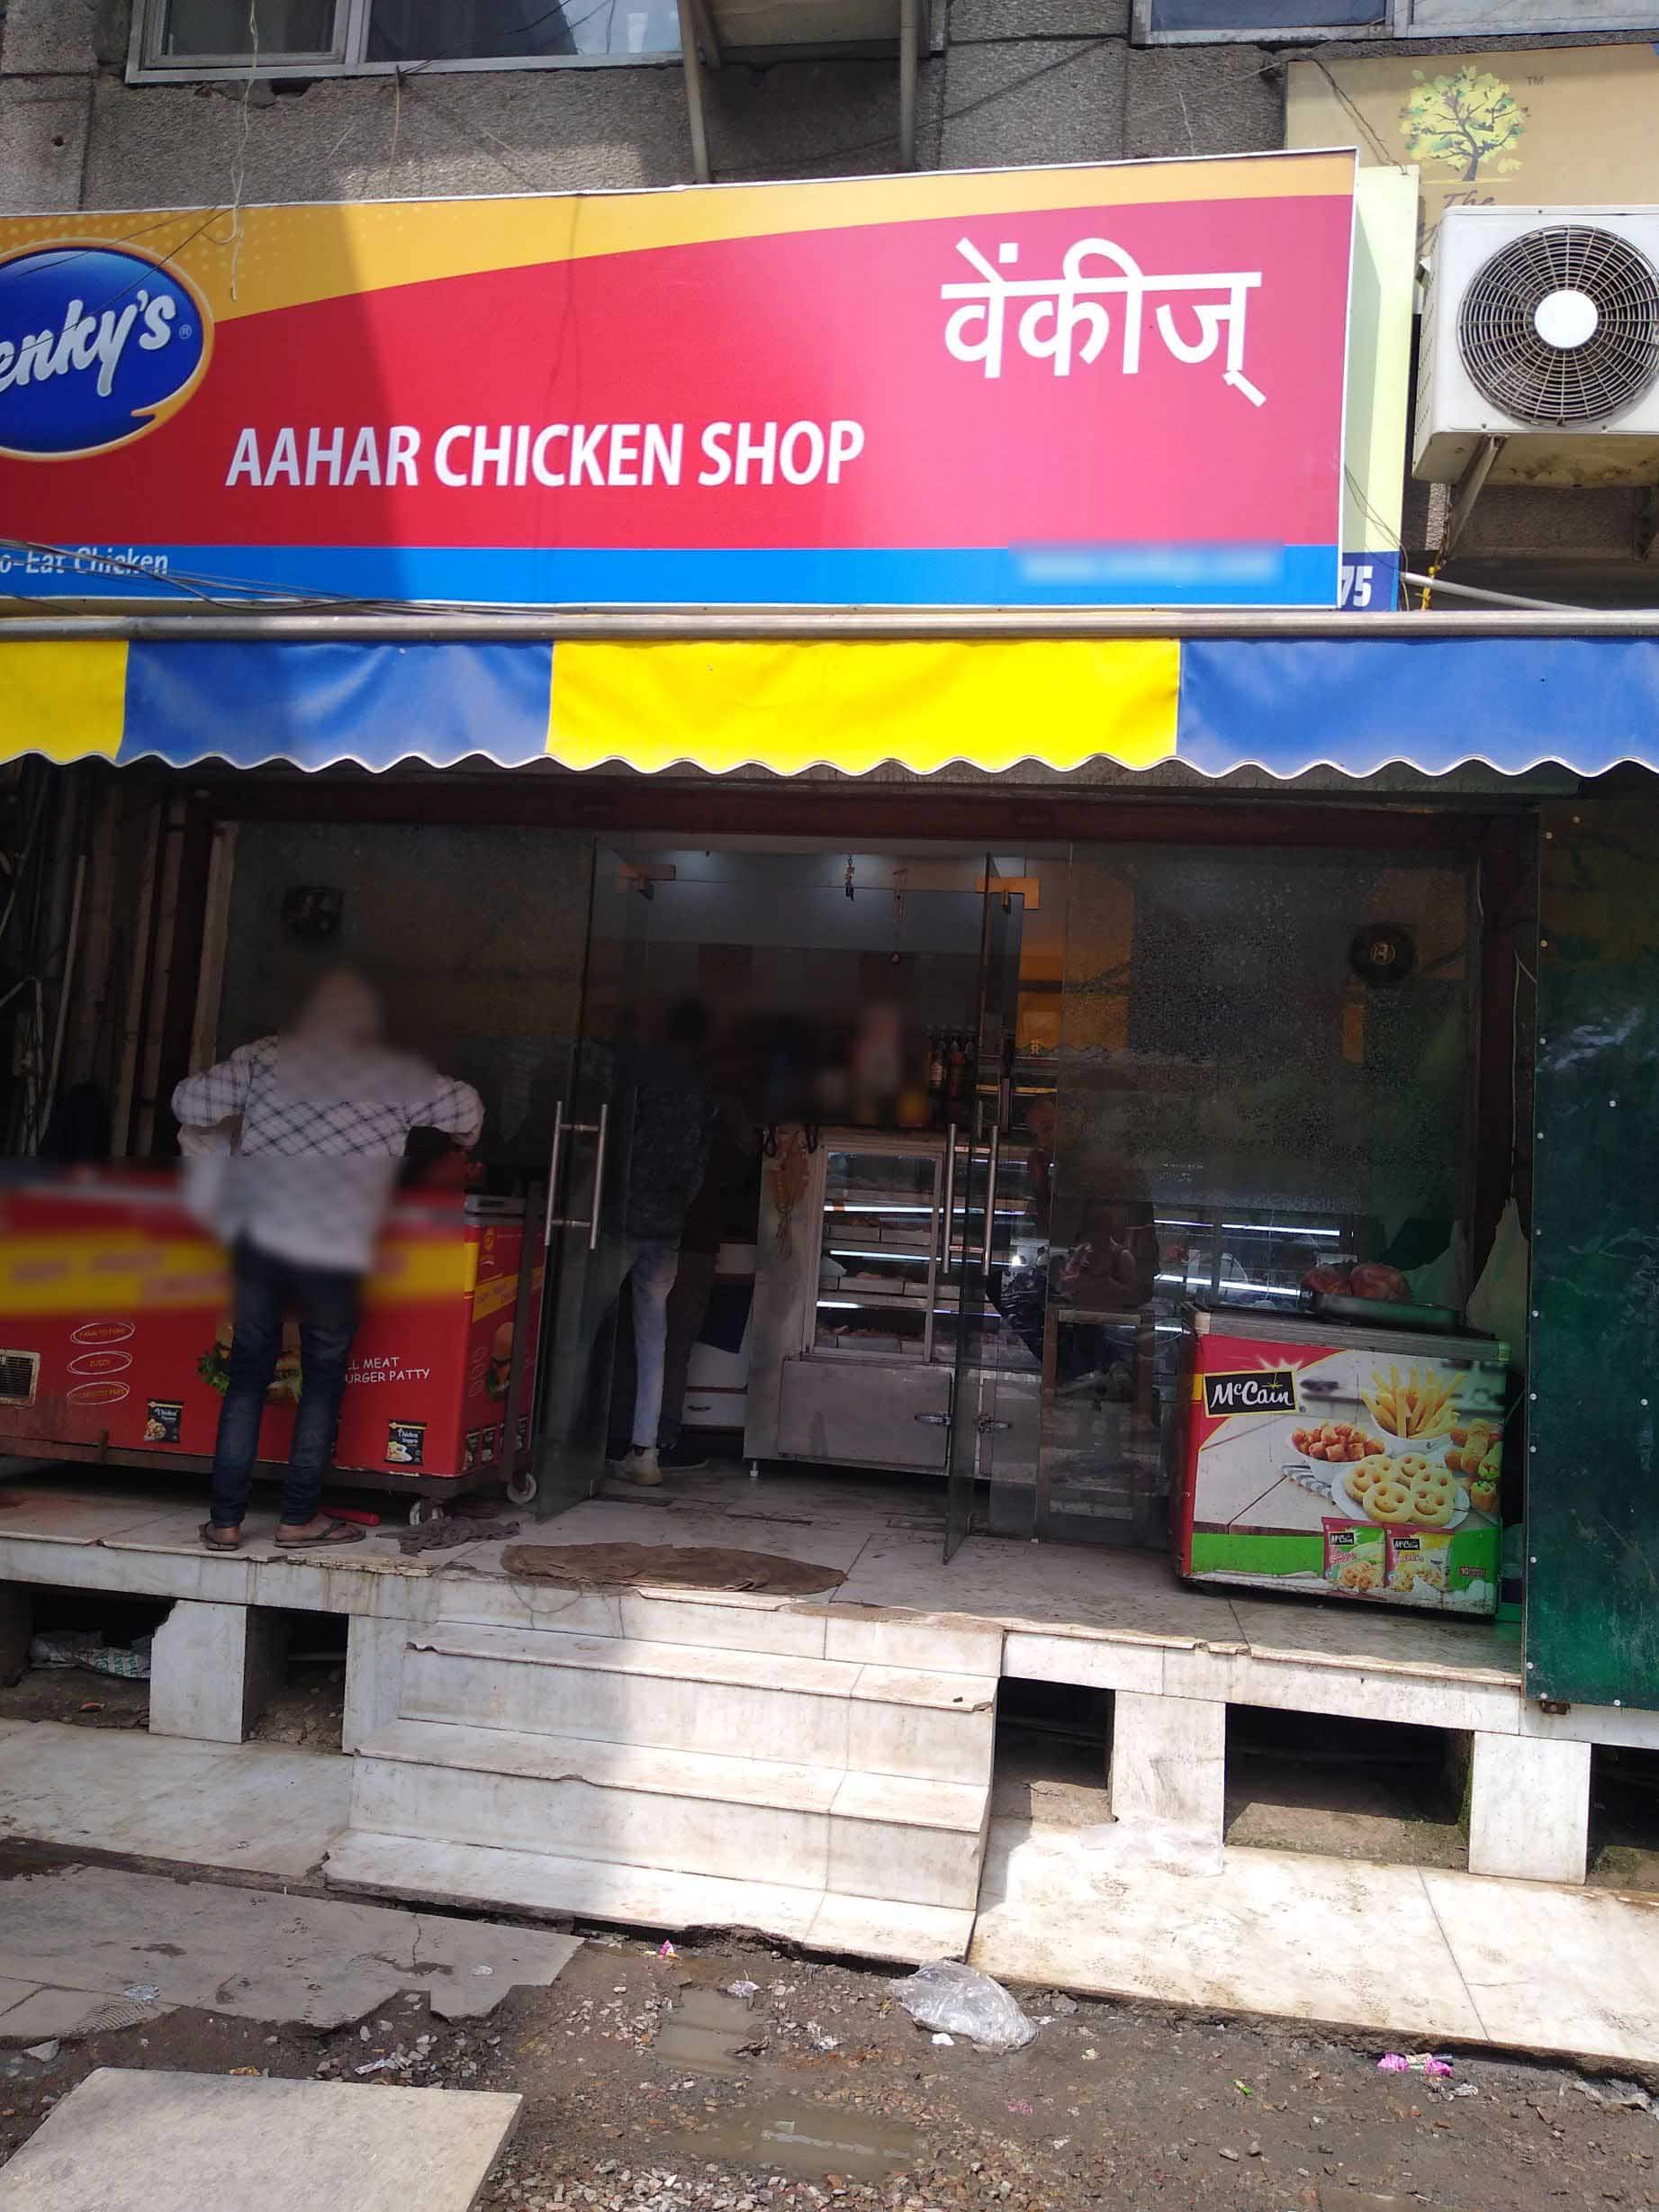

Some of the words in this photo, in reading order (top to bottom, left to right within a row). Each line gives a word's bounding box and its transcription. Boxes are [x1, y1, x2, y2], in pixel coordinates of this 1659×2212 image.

[941, 237, 1267, 407] वेंकीज्
[225, 426, 421, 486] AAHAR
[435, 424, 684, 487] CHICKEN
[698, 420, 865, 486] SHOP
[73, 546, 169, 575] Chicken
[1341, 564, 1374, 608] 75
[345, 1371, 386, 1384] URGER
[389, 1368, 430, 1382] PATTY
[363, 1356, 400, 1369] MEAT
[1210, 1380, 1294, 1409] McCain
